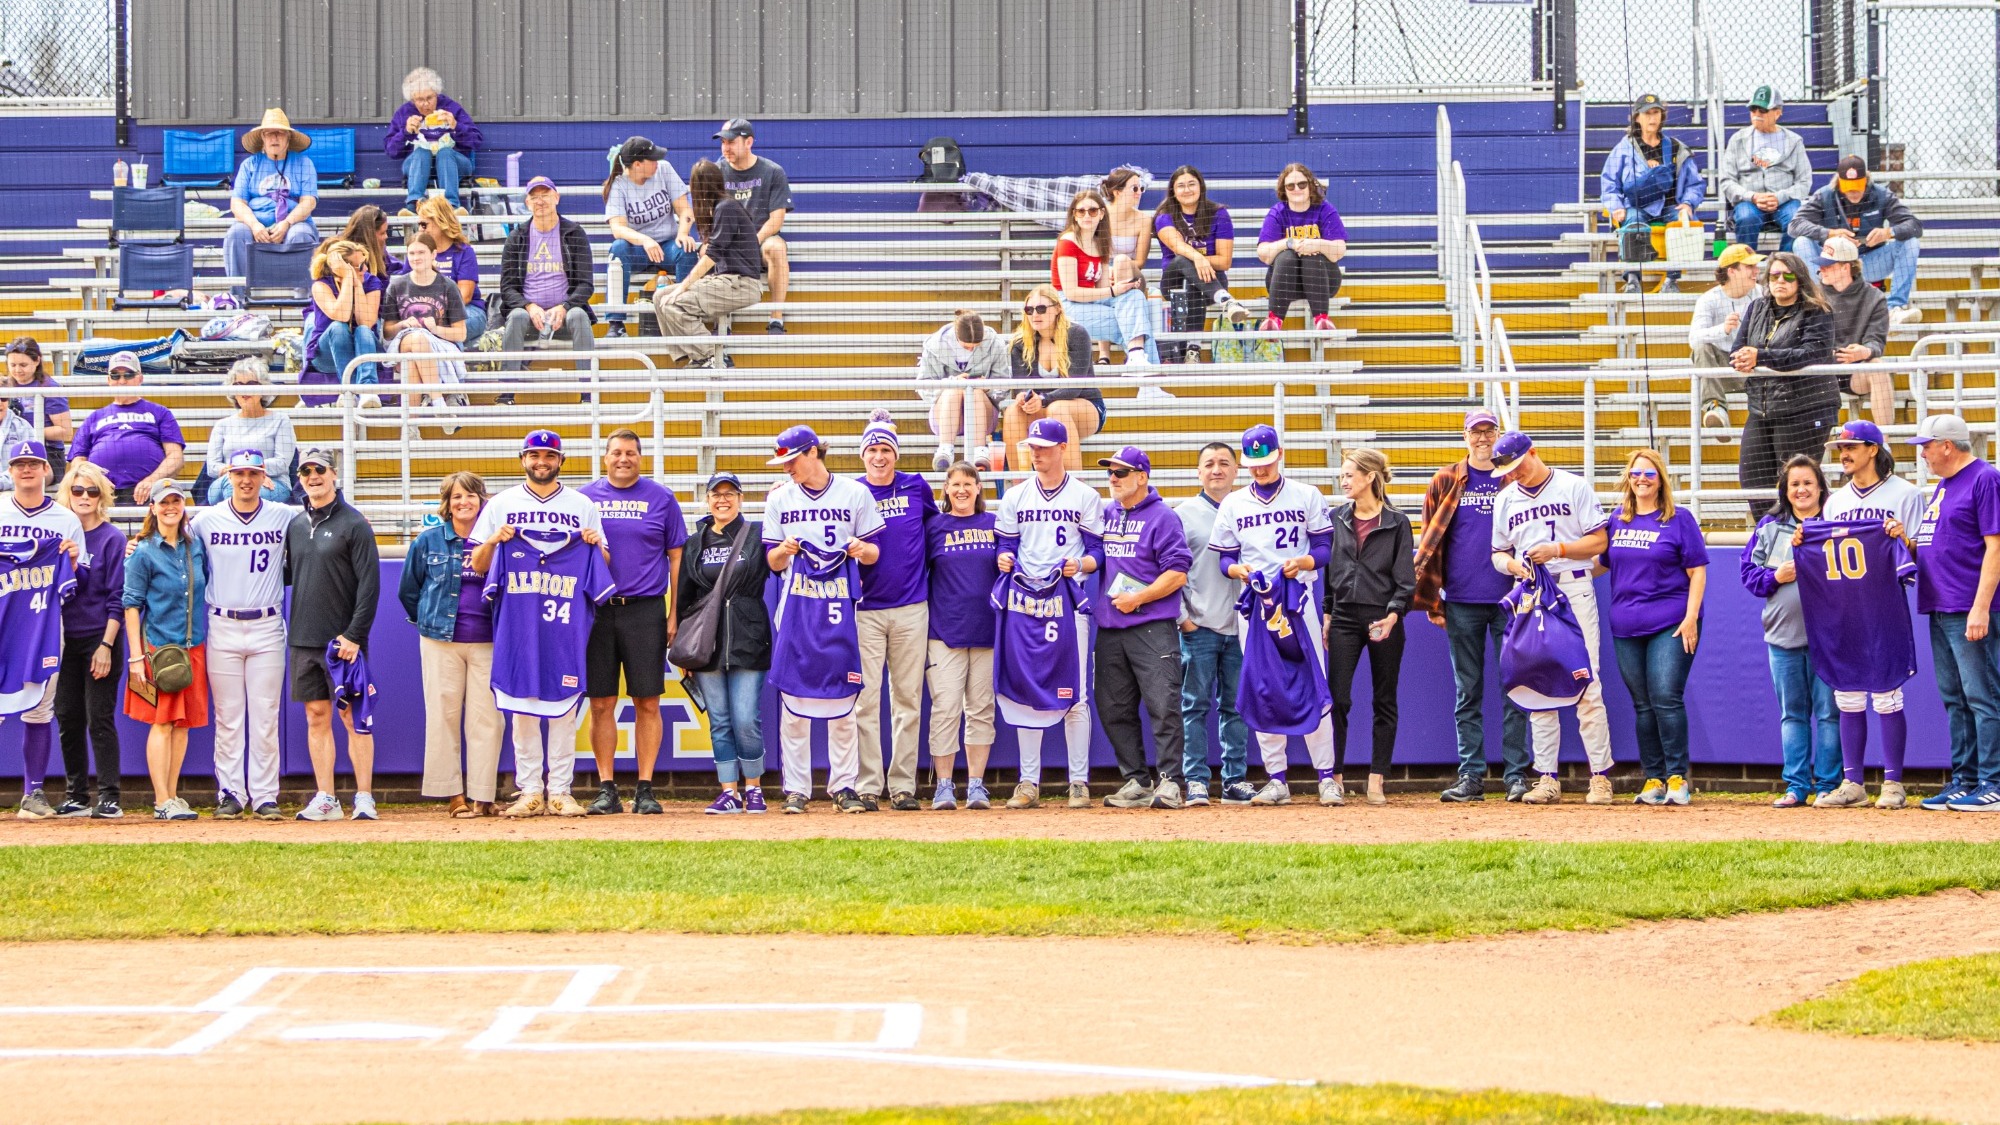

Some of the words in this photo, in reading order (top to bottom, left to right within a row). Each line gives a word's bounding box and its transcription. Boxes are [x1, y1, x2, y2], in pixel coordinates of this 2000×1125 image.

[627, 189, 673, 215] ALBION
[627, 203, 671, 225] COLLEG
[533, 242, 553, 260] A
[868, 432, 880, 445] A
[1029, 422, 1042, 436] A
[19, 442, 34, 455] A
[506, 511, 581, 529] BRITONS
[780, 508, 851, 525] BRITONS
[1017, 510, 1082, 524] BRITONS
[1236, 510, 1306, 532] BRITONS
[1508, 503, 1571, 532] BRITONS
[0, 525, 64, 540] RITONS
[210, 530, 284, 546] BRITONS
[824, 525, 837, 547] 5
[944, 528, 995, 547] ALBION
[1055, 526, 1067, 547] 6
[1275, 526, 1300, 549] 24
[1545, 520, 1556, 541] 7
[1611, 529, 1661, 543] ALBION
[944, 543, 996, 552] BASEBALL
[249, 548, 270, 573] 13
[703, 555, 746, 565] BASEL
[1822, 537, 1867, 581] 10
[507, 572, 578, 598] ALBION
[542, 600, 571, 624] 34
[828, 602, 842, 624] 5
[1044, 621, 1059, 642] 6
